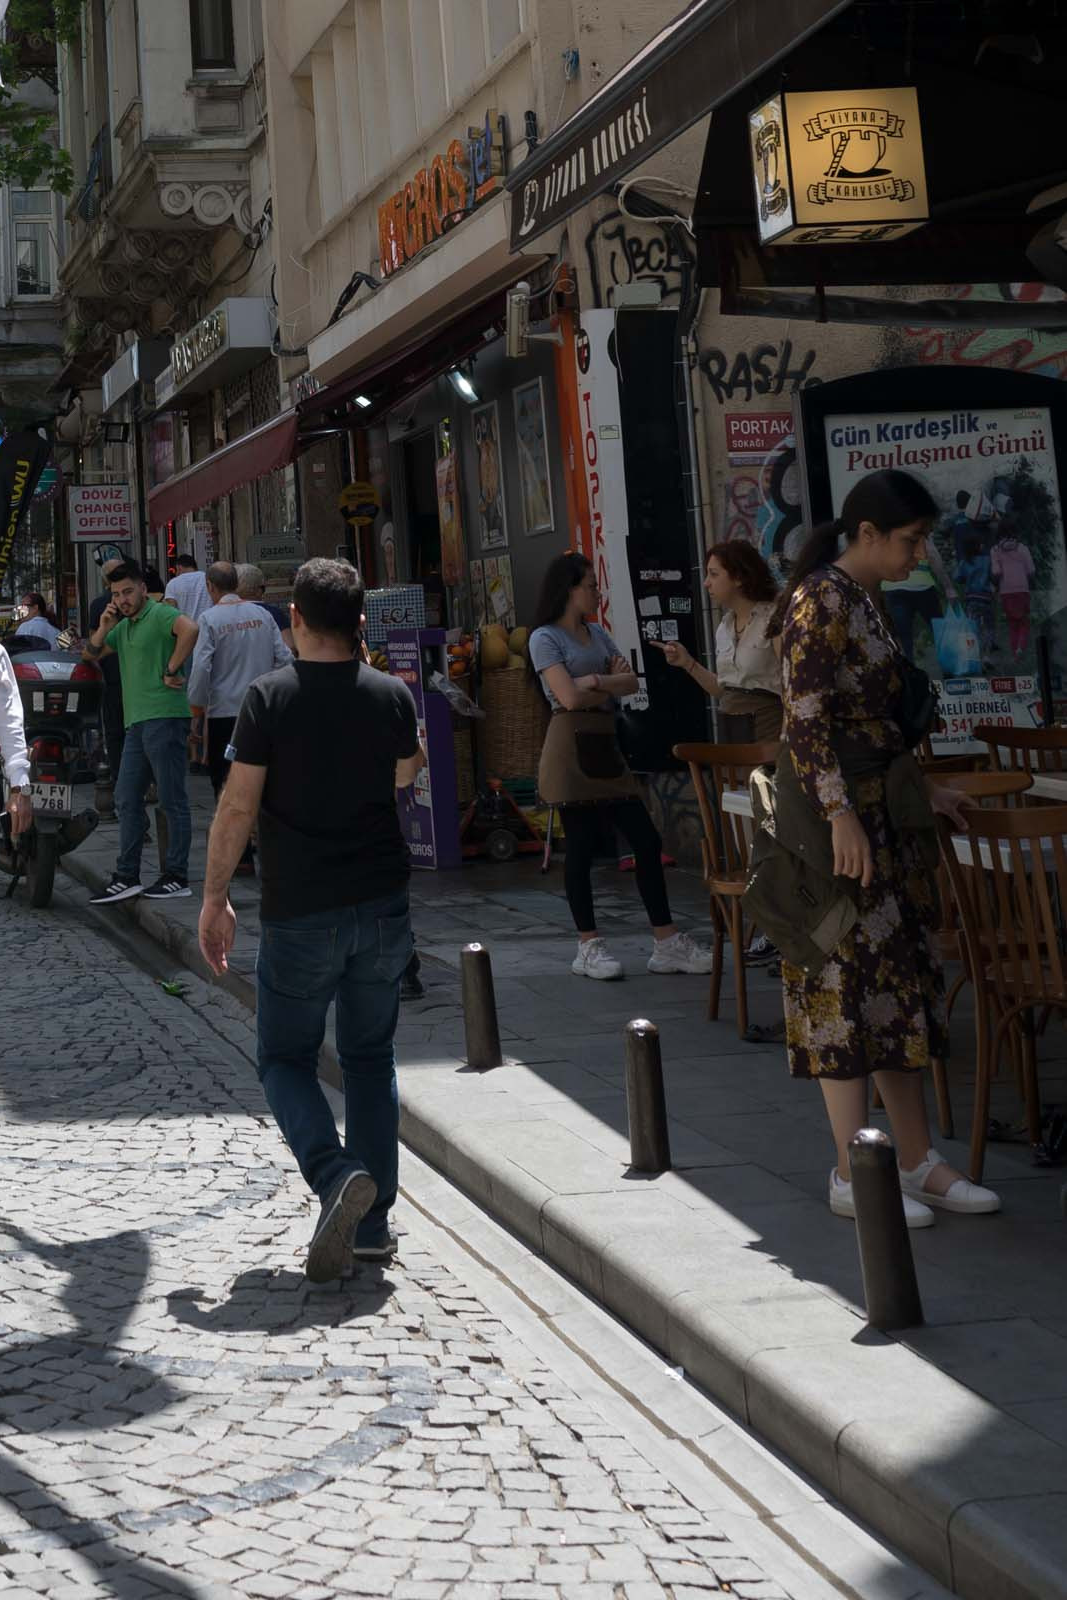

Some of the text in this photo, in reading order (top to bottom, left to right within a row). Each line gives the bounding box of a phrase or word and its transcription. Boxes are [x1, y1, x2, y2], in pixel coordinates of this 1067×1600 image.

[730, 418, 794, 437] PORTAK
[830, 412, 998, 448] Gün Kardeşlik ve
[732, 438, 765, 449] SOKAĞI
[846, 430, 1047, 472] Paylaşma Günü
[82, 488, 123, 500] DÖVİZ
[74, 503, 132, 514] CHANGE
[965, 698, 1012, 715] DERNEĞİ
[49, 785, 66, 796] FV
[41, 798, 64, 810] 768
